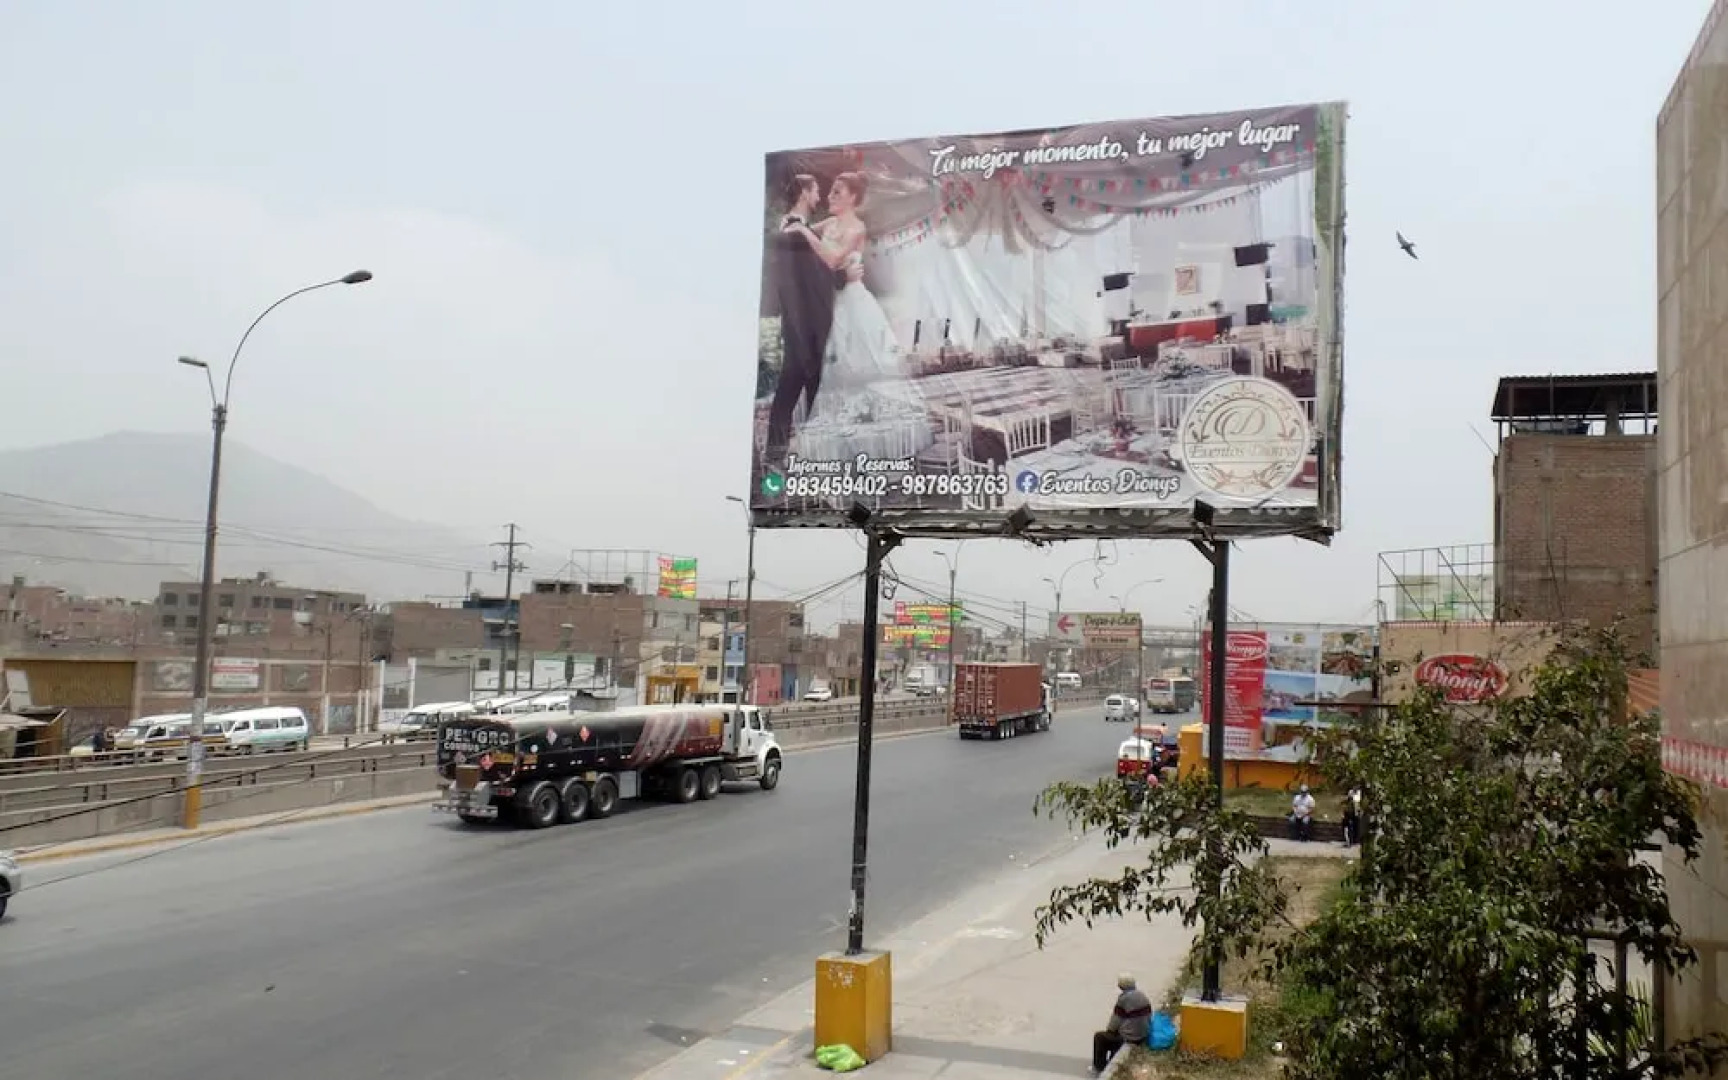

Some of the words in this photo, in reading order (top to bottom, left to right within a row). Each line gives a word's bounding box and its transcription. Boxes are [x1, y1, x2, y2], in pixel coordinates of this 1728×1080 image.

[929, 146, 955, 178] Tu
[959, 147, 1019, 179] mejor
[1023, 135, 1130, 165] momento,
[1136, 131, 1161, 155] tu
[1167, 126, 1233, 161] mejor
[1238, 120, 1300, 153] lugar
[787, 454, 842, 476] Informes
[844, 461, 852, 478] y
[855, 453, 916, 474] Reservas:
[785, 475, 888, 497] 983459402
[901, 473, 1010, 496] 987863763
[1039, 470, 1111, 495] Eventos
[1115, 468, 1181, 499] Dionys
